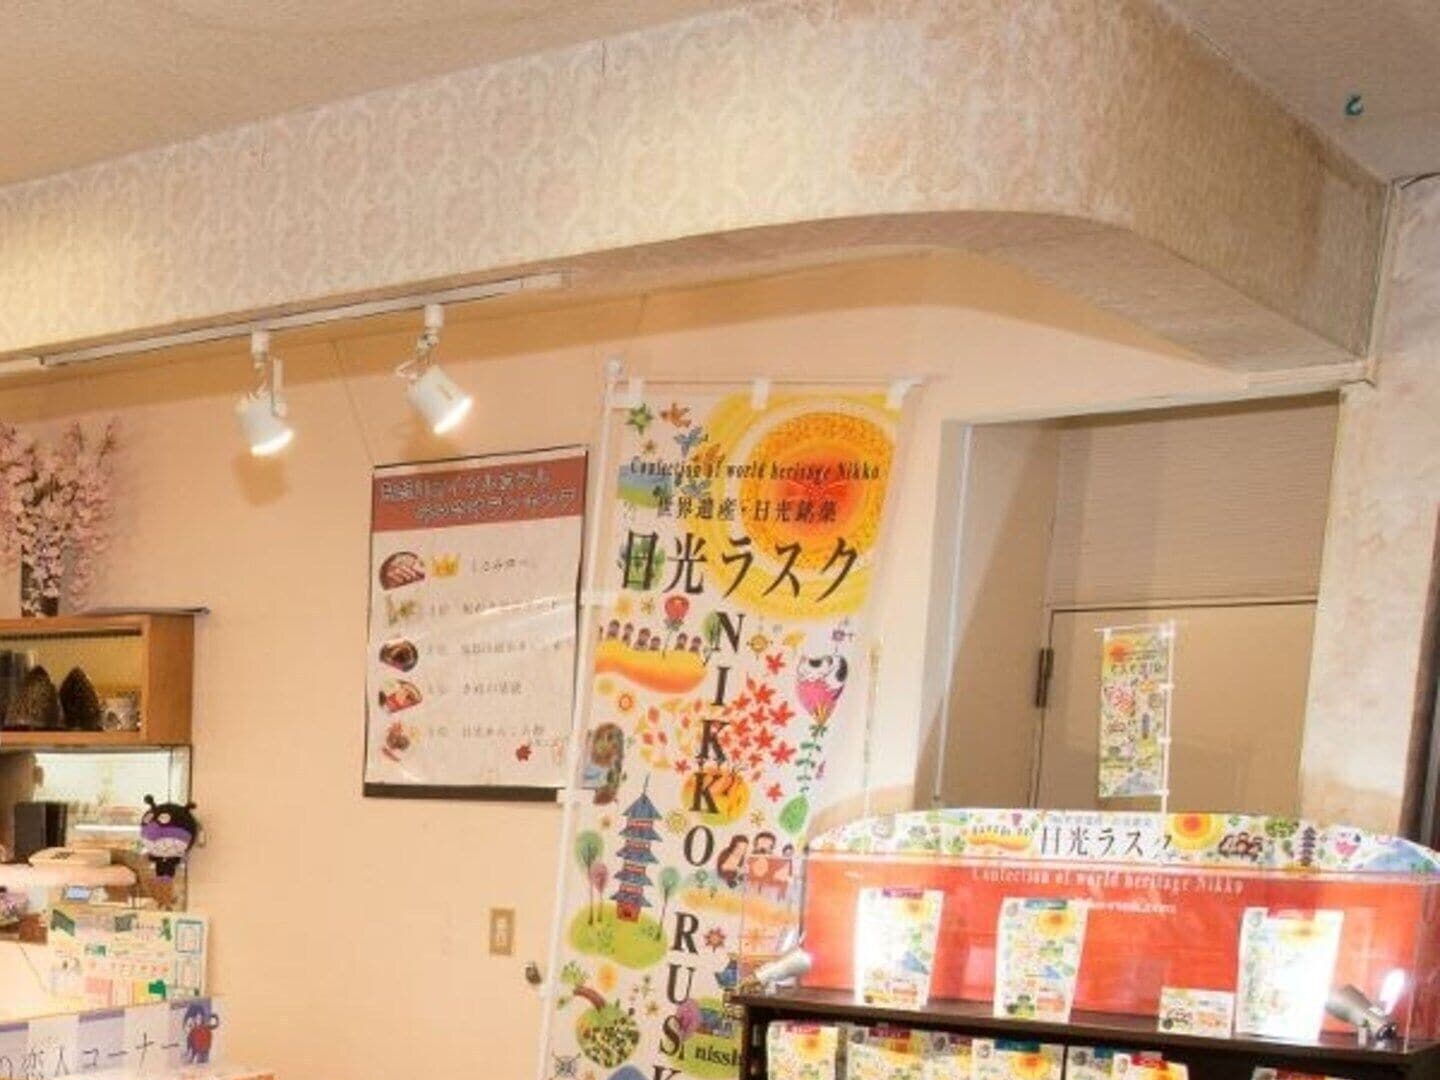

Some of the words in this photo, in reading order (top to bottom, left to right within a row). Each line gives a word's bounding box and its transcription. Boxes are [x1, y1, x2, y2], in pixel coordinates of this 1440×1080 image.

[727, 461, 765, 480] world
[770, 462, 830, 484] heritage
[836, 460, 880, 480] Nikko
[621, 529, 859, 602] 日光ラスク
[683, 611, 746, 867] NIKKO
[1040, 824, 1173, 858] 日光ラスク
[972, 867, 1050, 885] Confection
[1055, 871, 1070, 885] of
[1076, 871, 1119, 890] world
[1124, 873, 1189, 894] heritage
[1196, 876, 1243, 895] Nikko
